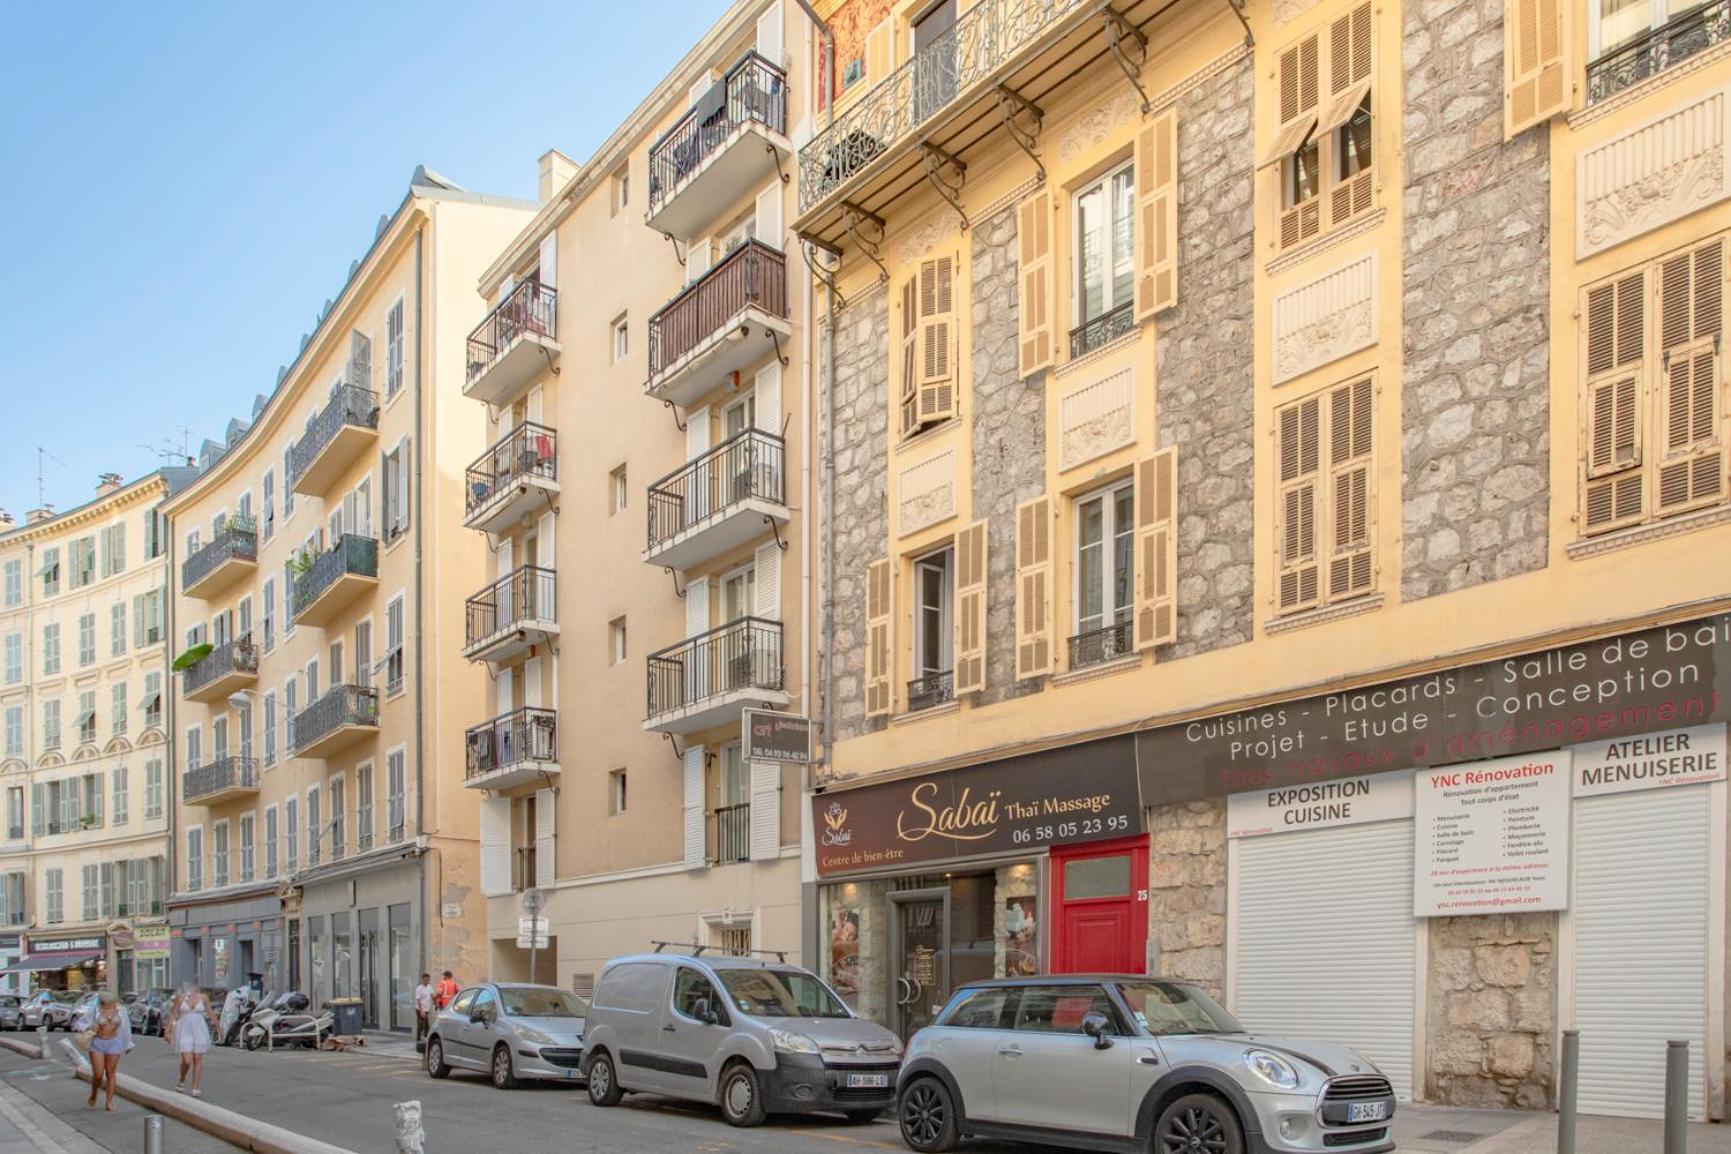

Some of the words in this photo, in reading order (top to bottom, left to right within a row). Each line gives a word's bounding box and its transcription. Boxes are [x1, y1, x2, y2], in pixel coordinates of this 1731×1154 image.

[1186, 709, 1288, 744] Cuisines
[1325, 675, 1456, 718] Placards
[1503, 649, 1588, 684] Salle
[1602, 638, 1649, 665] de
[1230, 730, 1305, 761] Projet
[1344, 712, 1430, 742] Etude
[1476, 663, 1700, 719] Conception
[1605, 733, 1691, 761] ATELIER
[1431, 773, 1461, 789] YNC
[1465, 763, 1554, 785] Rénovation
[1582, 752, 1718, 786] MENUISERIE
[1267, 779, 1371, 808] EXPOSITION
[897, 782, 1002, 841] Sabaï
[1004, 801, 1039, 820] Thaï
[1043, 794, 1111, 816] Massage
[1284, 803, 1352, 825] CUISINE
[1012, 828, 1031, 844] 06
[1035, 825, 1054, 841] 58
[1058, 822, 1078, 838] 05
[1082, 818, 1102, 834] 23
[1108, 815, 1128, 831] 95
[822, 854, 850, 868] Centre
[851, 852, 862, 863] de
